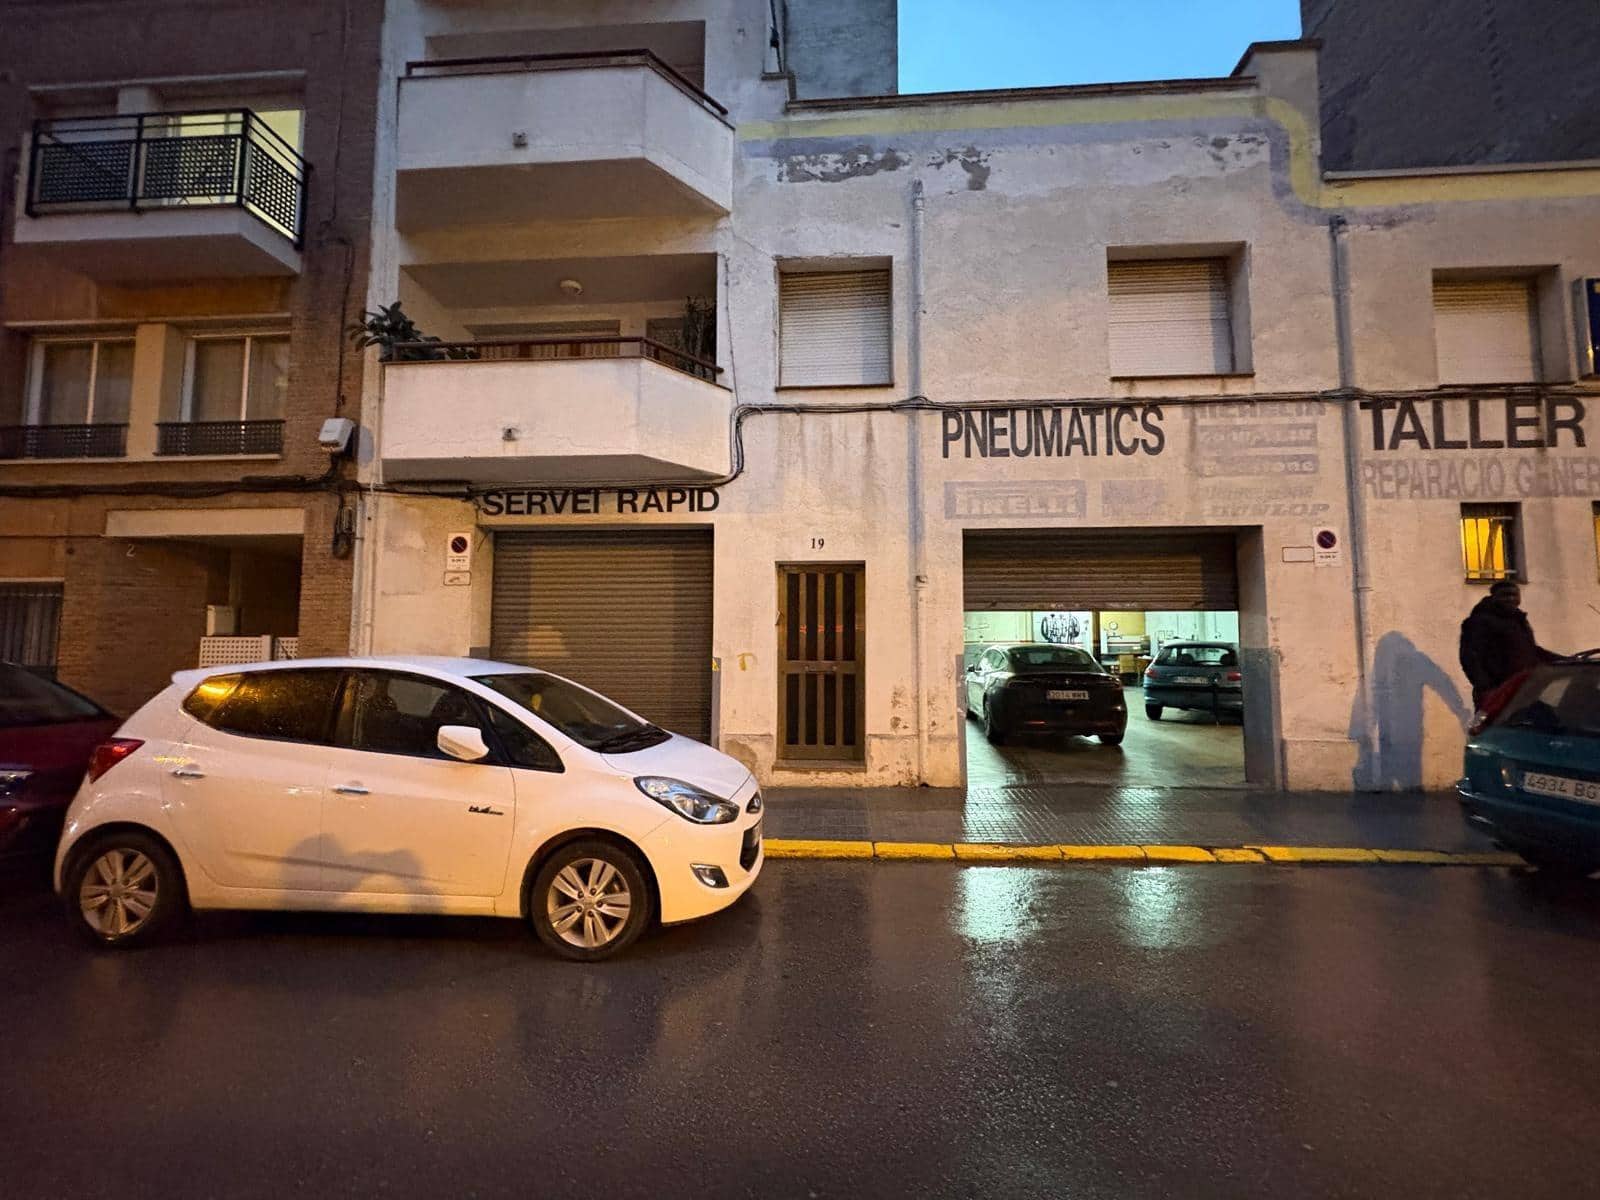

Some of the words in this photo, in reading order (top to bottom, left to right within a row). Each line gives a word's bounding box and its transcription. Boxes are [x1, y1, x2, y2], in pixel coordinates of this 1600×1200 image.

[942, 404, 1166, 458] PNEUMATICS
[1359, 397, 1587, 450] TALLER
[482, 488, 600, 516] SERVEI
[617, 486, 720, 513] RAPID
[810, 537, 825, 550] 19
